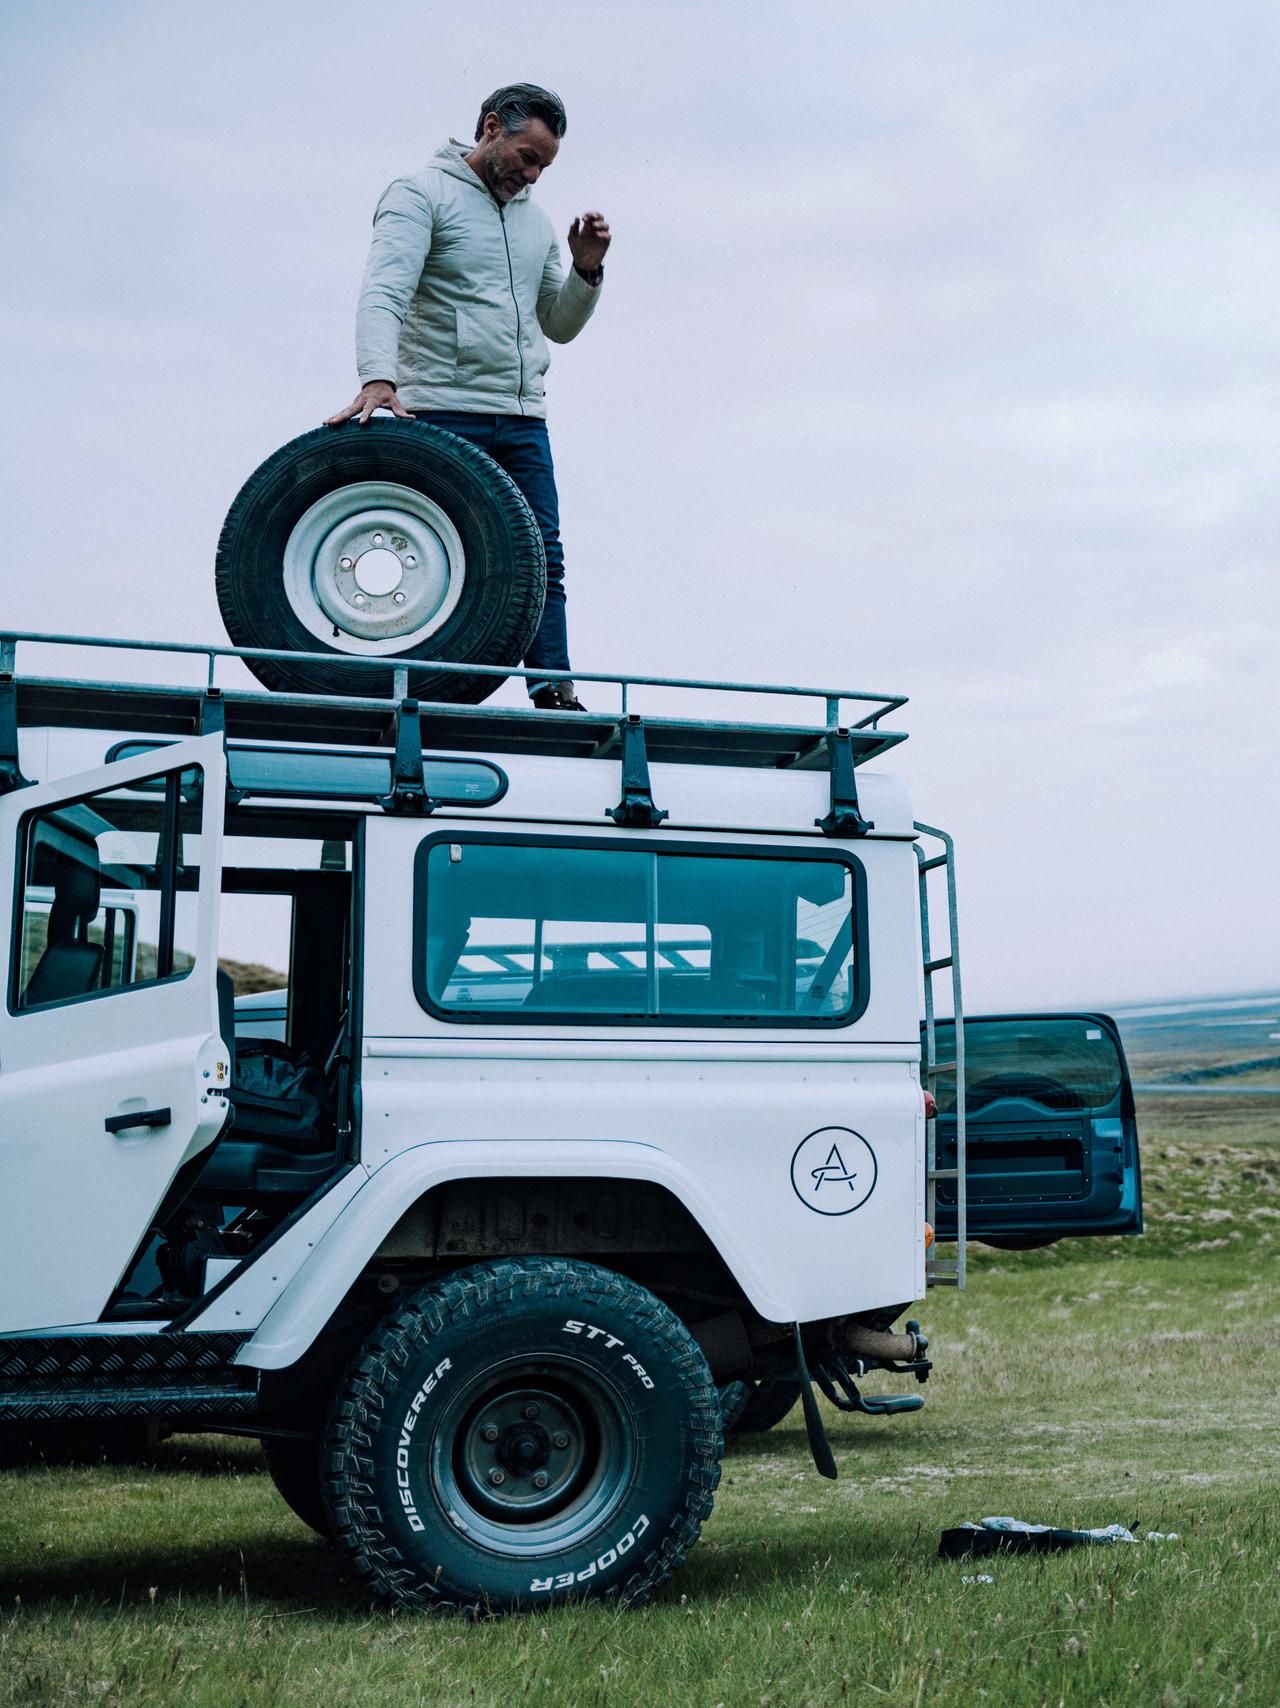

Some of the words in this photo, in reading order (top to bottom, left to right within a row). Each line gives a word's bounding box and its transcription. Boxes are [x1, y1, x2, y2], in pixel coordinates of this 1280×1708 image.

[562, 1320, 625, 1348] STT
[622, 1353, 655, 1389] PRO
[397, 1357, 452, 1532] DISCOVERER
[530, 1514, 650, 1592] COOPER
